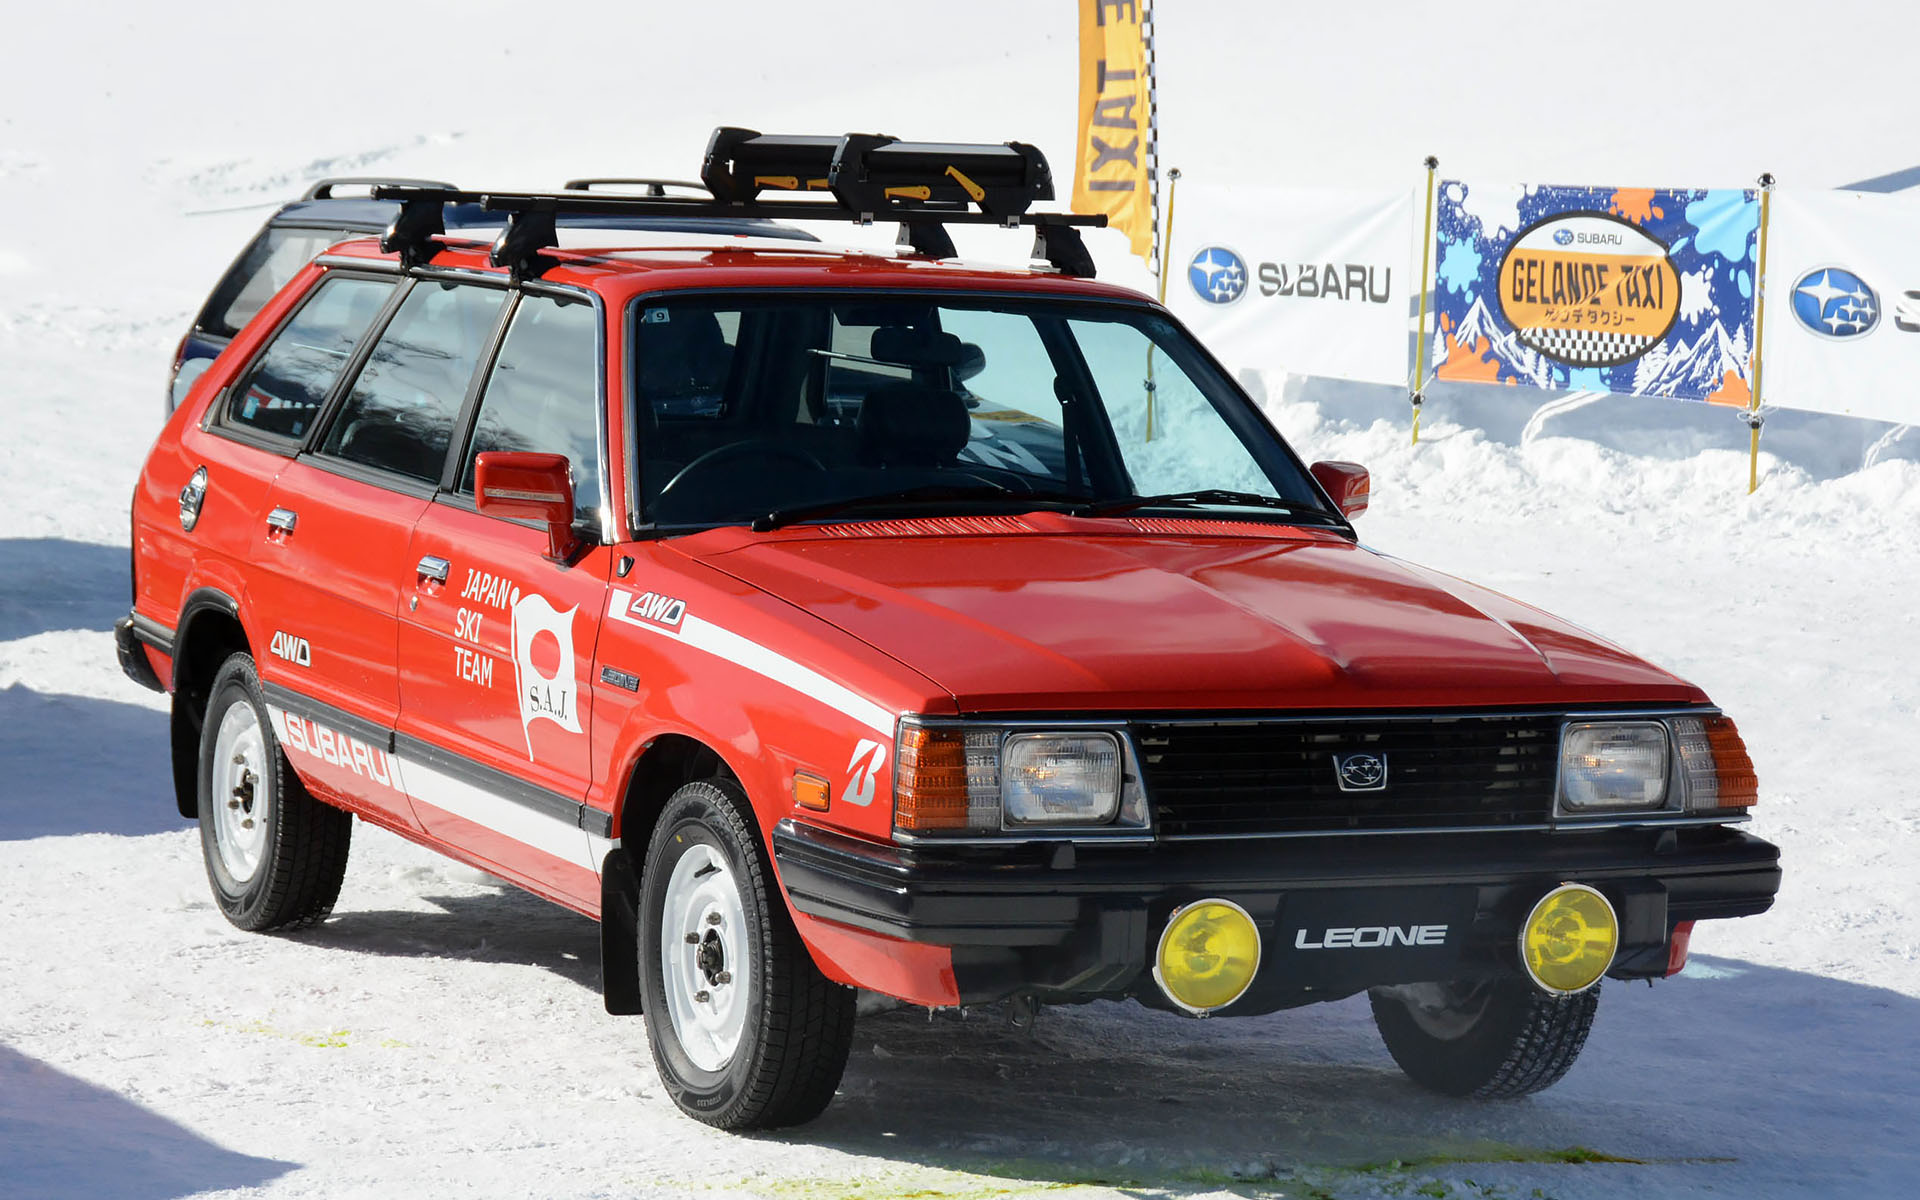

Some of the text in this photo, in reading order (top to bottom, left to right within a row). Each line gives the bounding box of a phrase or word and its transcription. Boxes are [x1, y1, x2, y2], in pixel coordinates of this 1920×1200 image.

[1577, 232, 1622, 245] SUBARU
[1258, 262, 1391, 303] SUBARU
[1616, 264, 1664, 310] TAXI
[461, 568, 511, 610] JAPAN
[454, 607, 483, 644] SKI
[630, 592, 686, 626] 4WD
[270, 630, 312, 668] 4WD
[454, 646, 494, 689] TEAM
[286, 712, 391, 787] SUBARU
[1295, 924, 1448, 950] LEONE
